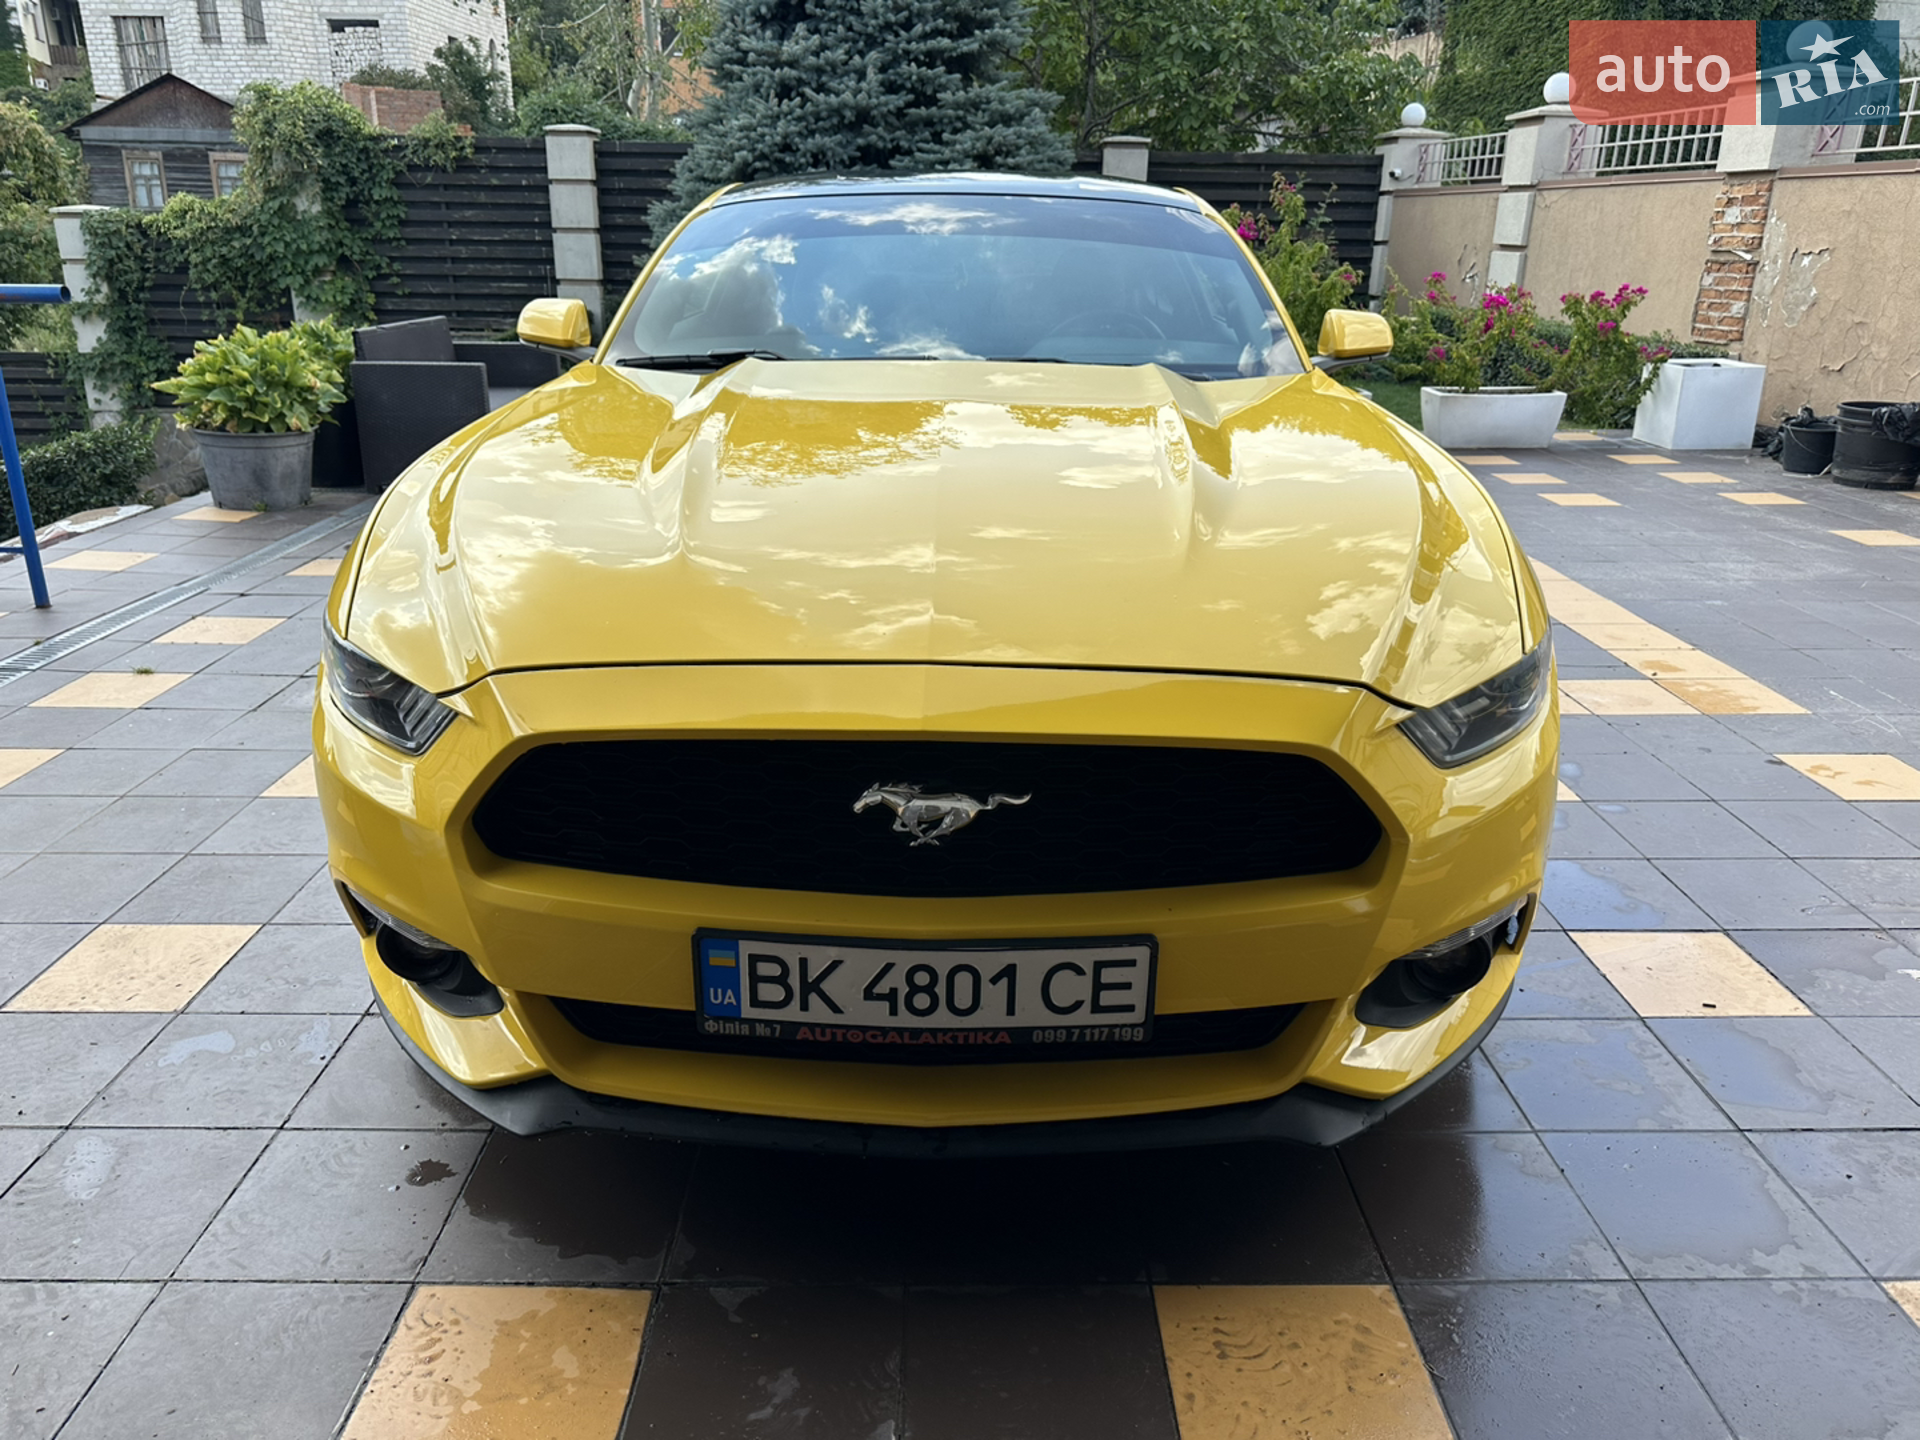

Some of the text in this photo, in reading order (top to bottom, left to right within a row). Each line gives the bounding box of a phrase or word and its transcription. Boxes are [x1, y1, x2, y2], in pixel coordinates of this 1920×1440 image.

[747, 952, 1138, 1018] BK 4801 CE
[709, 987, 737, 1006] UA
[704, 1019, 750, 1035] Філія
[795, 1026, 1012, 1044] AUTOGALAKTIKA
[1032, 1029, 1067, 1043] 099
